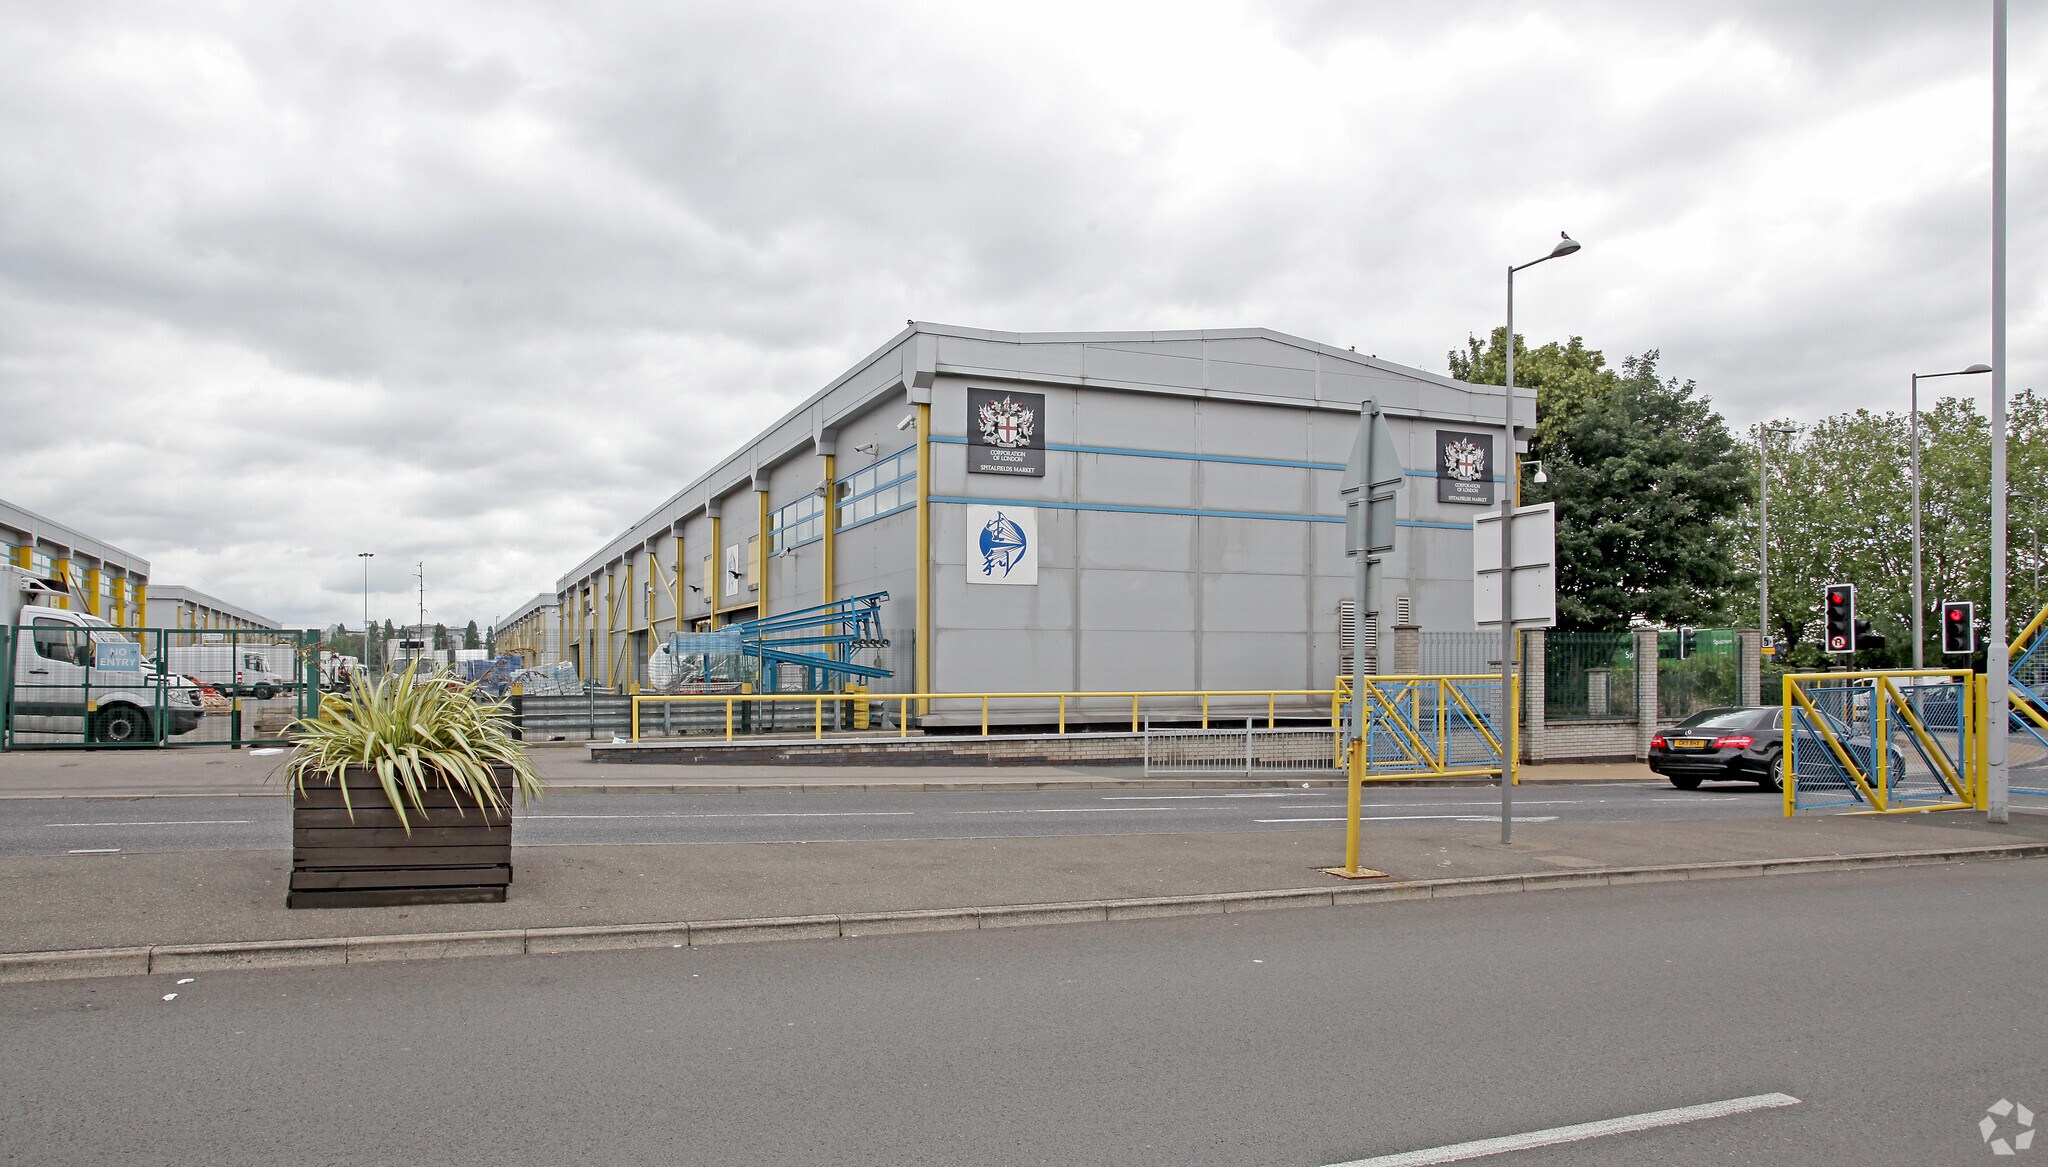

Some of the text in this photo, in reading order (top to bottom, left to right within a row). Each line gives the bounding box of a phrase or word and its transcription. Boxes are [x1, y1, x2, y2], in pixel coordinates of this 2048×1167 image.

[990, 449, 1026, 457] CORPORATION
[980, 464, 1013, 472] SPITALFIELDS
[110, 647, 127, 656] NO
[100, 657, 136, 667] ENTRY
